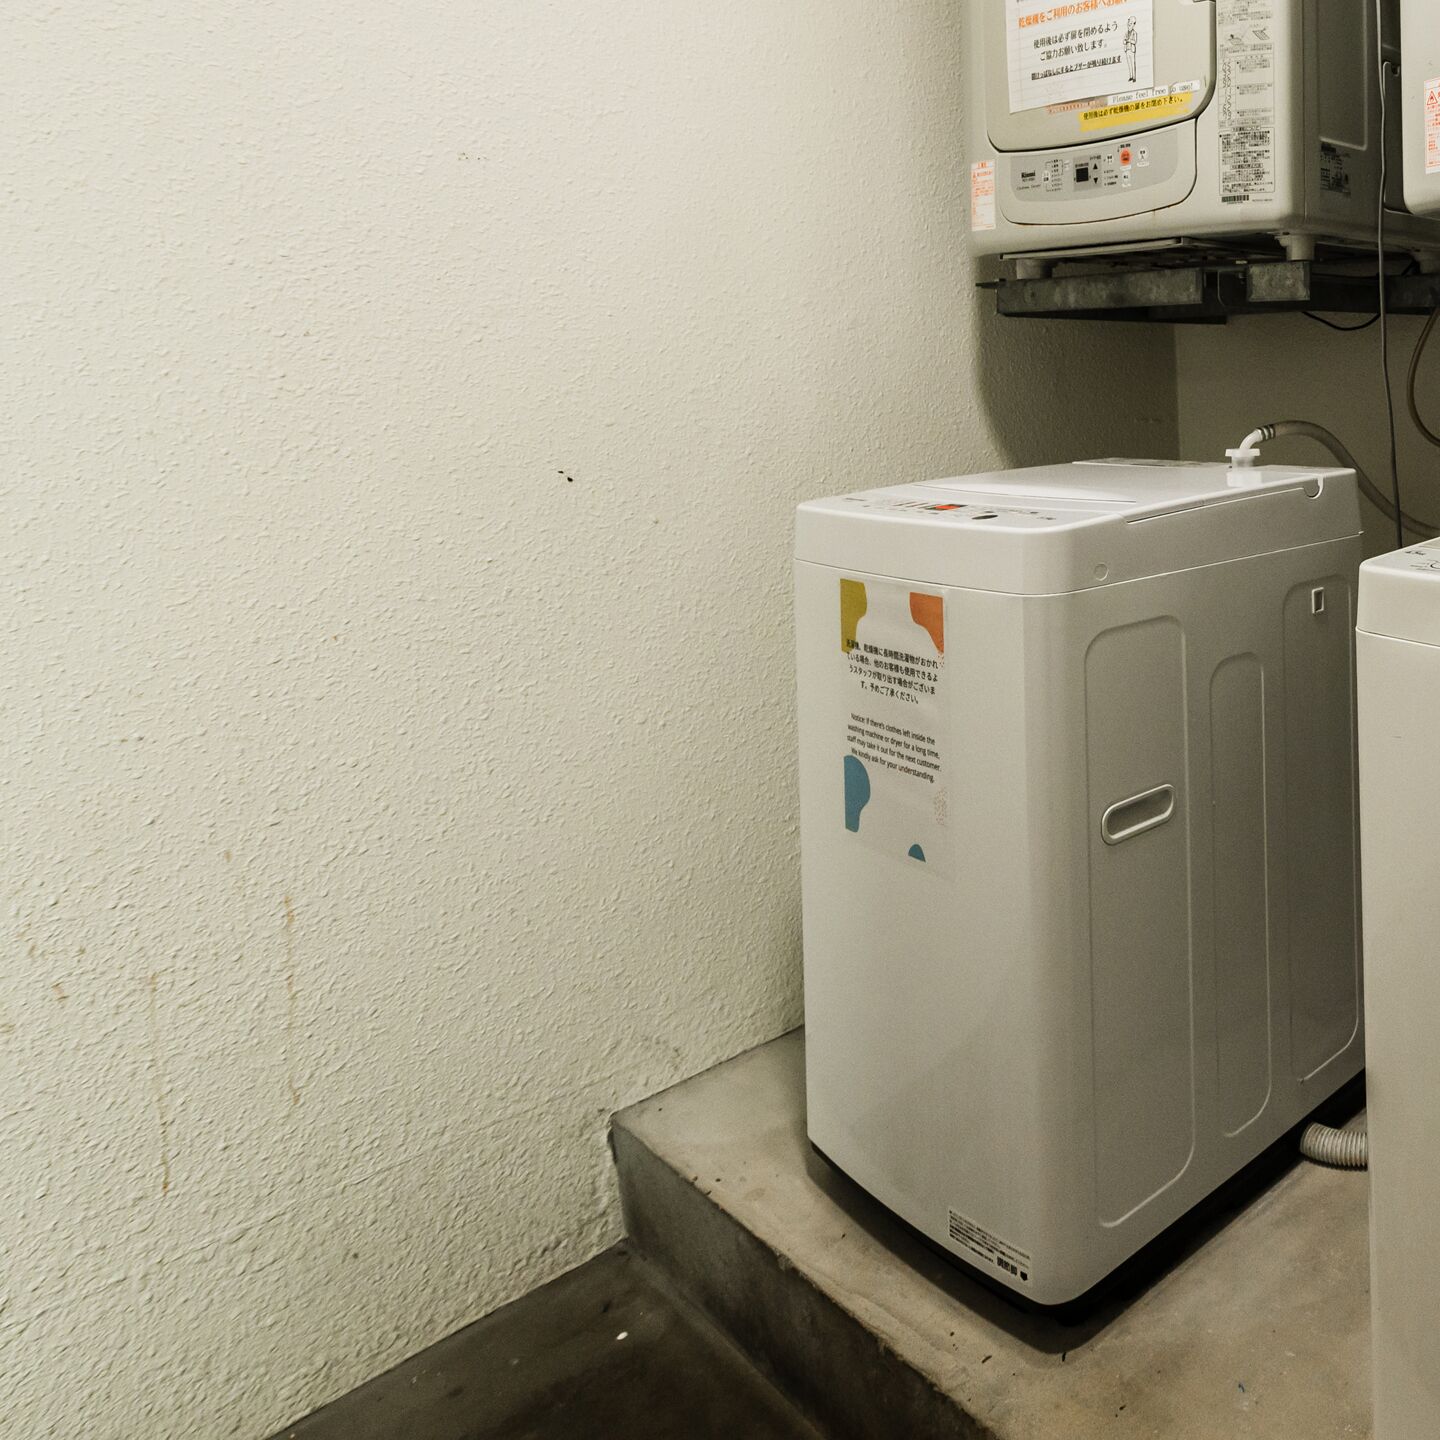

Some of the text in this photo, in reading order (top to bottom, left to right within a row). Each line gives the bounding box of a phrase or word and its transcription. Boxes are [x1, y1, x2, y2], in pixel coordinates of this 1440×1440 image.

[1034, 20, 1118, 49] 使用後は必ず扉を閉めるよう
[1040, 39, 1107, 61] ご協力お願い致します。
[1112, 94, 1132, 102] Please
[1136, 90, 1148, 99] feel
[1152, 88, 1166, 97] free
[850, 664, 936, 695] うスタッフが取り出す場合がございま
[848, 724, 865, 736] washing
[865, 730, 884, 741] machine
[890, 738, 902, 747] dryer
[916, 745, 926, 756] long
[886, 725, 902, 735] clothes
[902, 729, 910, 738] left
[911, 733, 926, 743] inside
[927, 737, 935, 745] the
[857, 739, 866, 748] may
[867, 742, 876, 750] take
[905, 755, 916, 764] next
[858, 750, 871, 761] kindly
[887, 761, 897, 769] your
